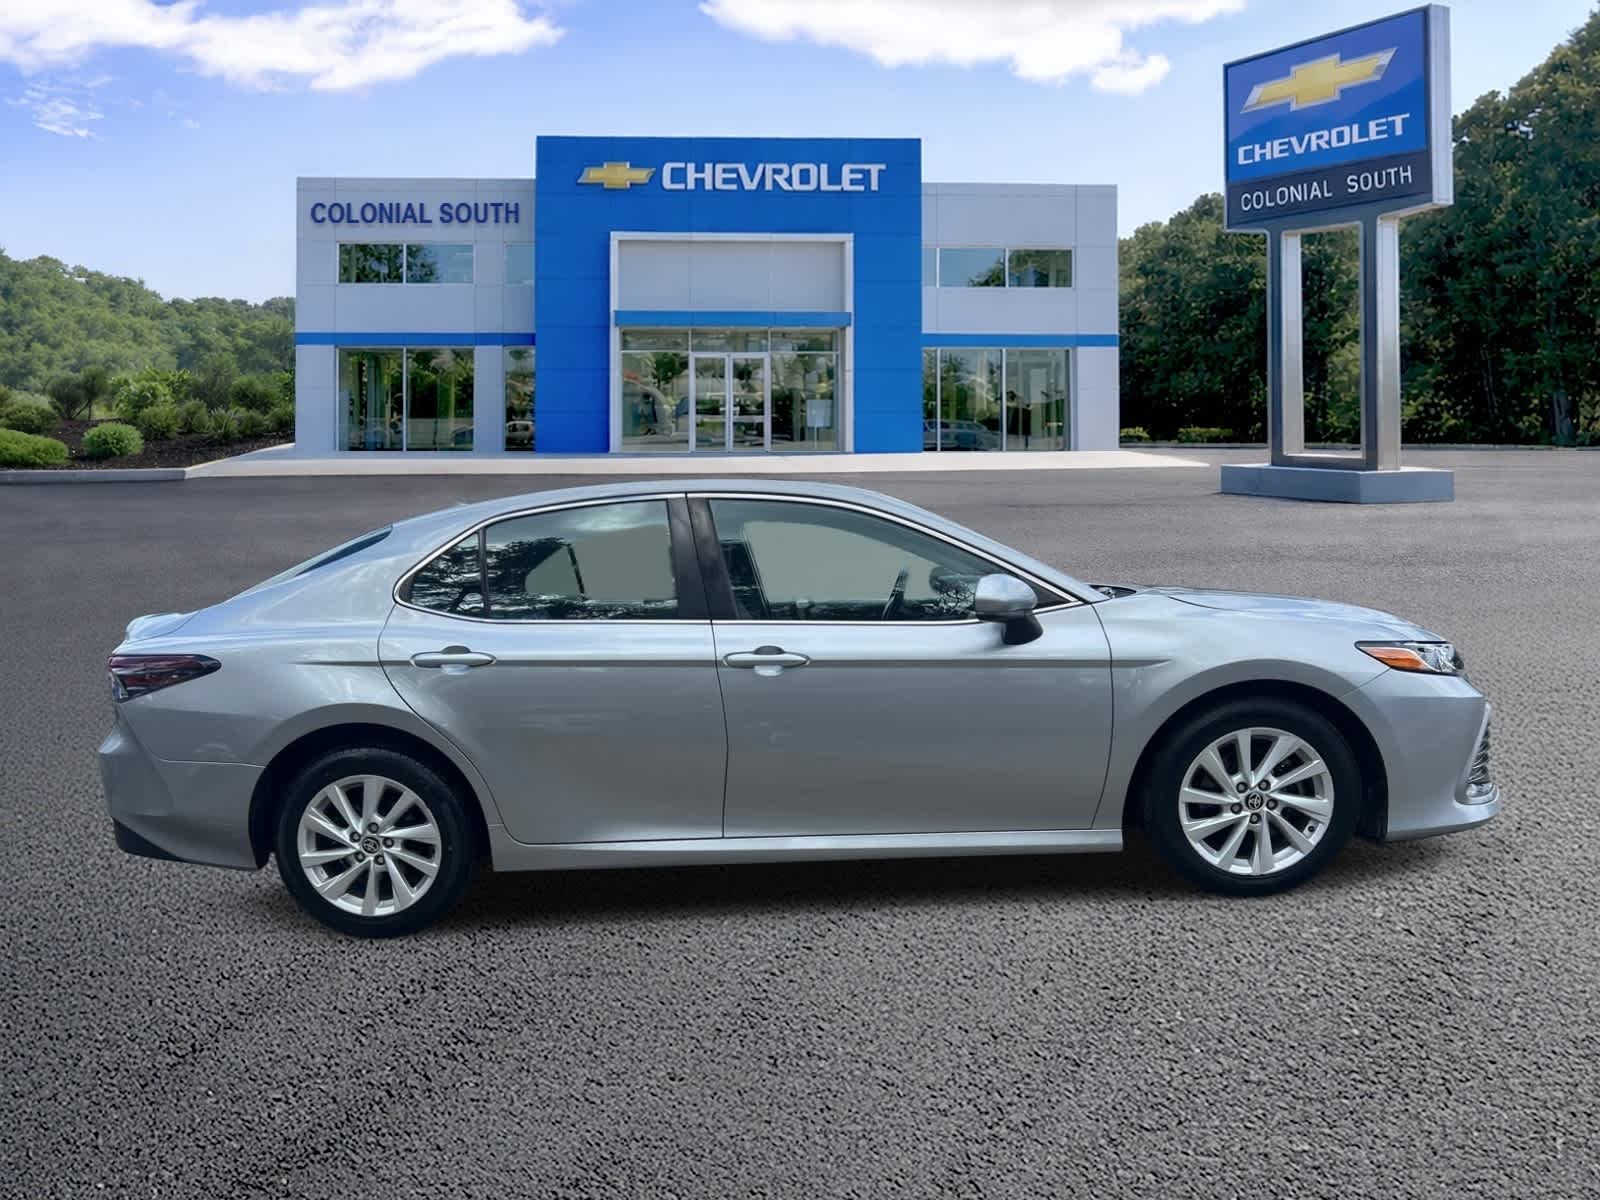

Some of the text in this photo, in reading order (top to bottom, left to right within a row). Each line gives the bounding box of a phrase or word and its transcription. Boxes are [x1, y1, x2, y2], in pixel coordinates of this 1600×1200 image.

[1238, 113, 1410, 165] CHEVROLET
[662, 161, 887, 192] CHEVROLET
[1241, 165, 1412, 211] COLONIAL SOUTH
[310, 202, 520, 225] COLONIAL SOUTH
